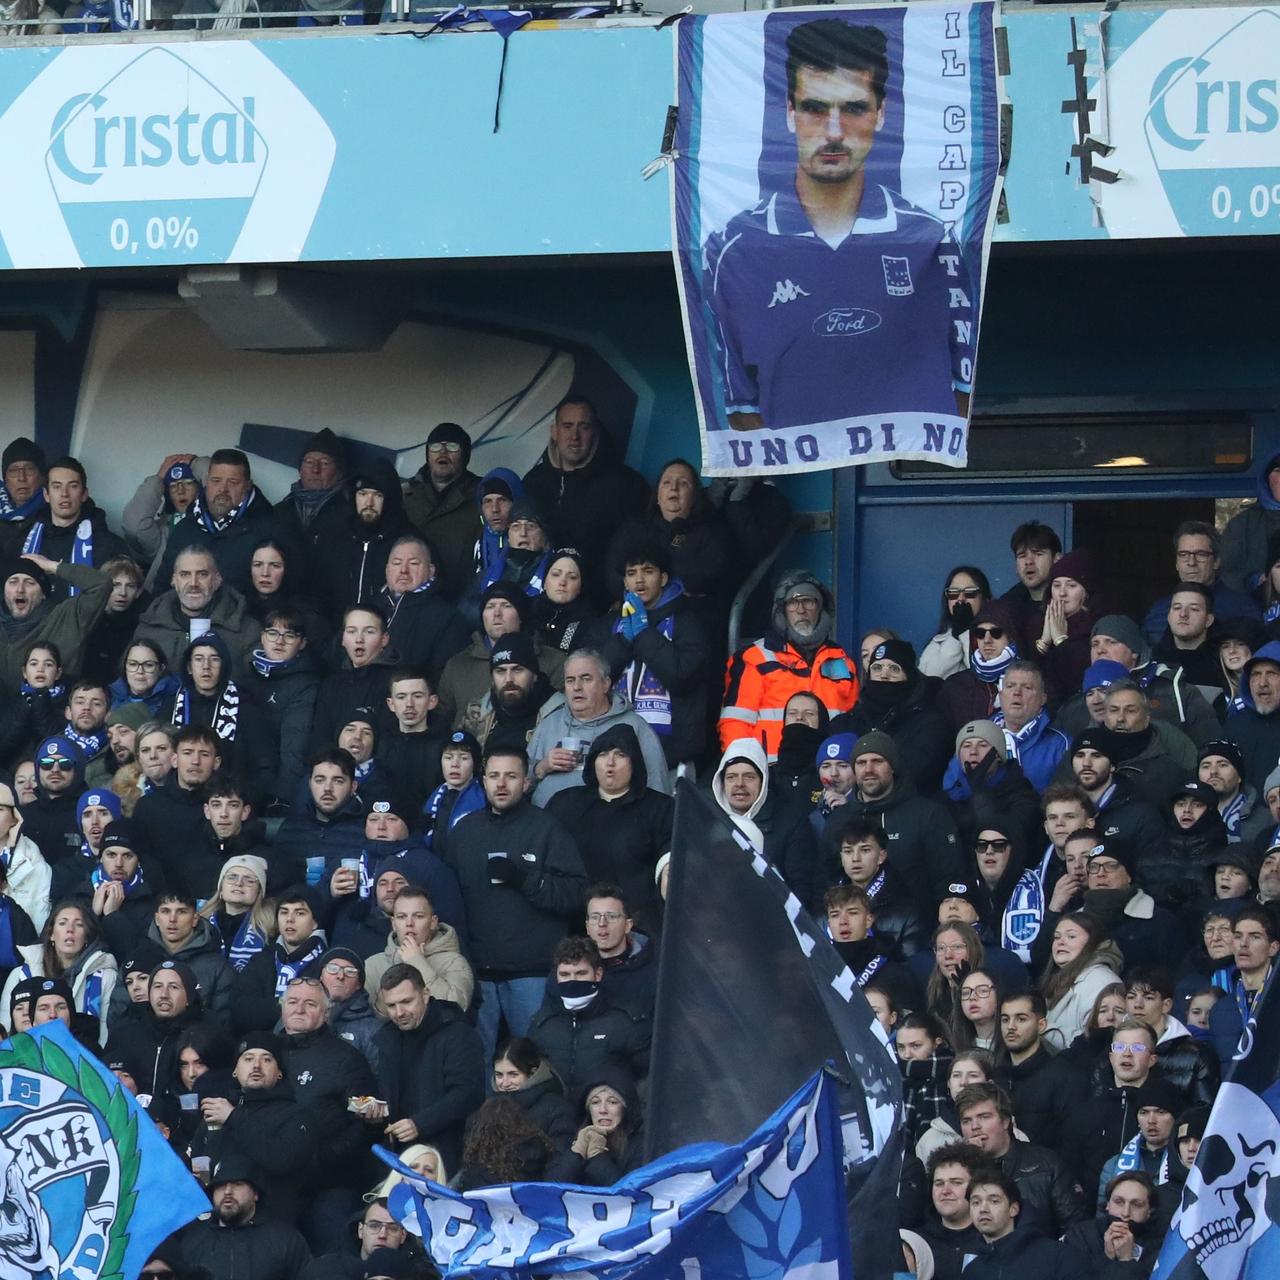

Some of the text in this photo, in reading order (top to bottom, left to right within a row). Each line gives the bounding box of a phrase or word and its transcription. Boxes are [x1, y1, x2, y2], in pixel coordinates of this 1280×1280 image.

[942, 11, 966, 78] IL
[49, 92, 257, 186] Cristal
[110, 216, 200, 255] 0,0%
[826, 311, 866, 333] Ford
[728, 433, 820, 467] UNO
[846, 422, 897, 456] DI
